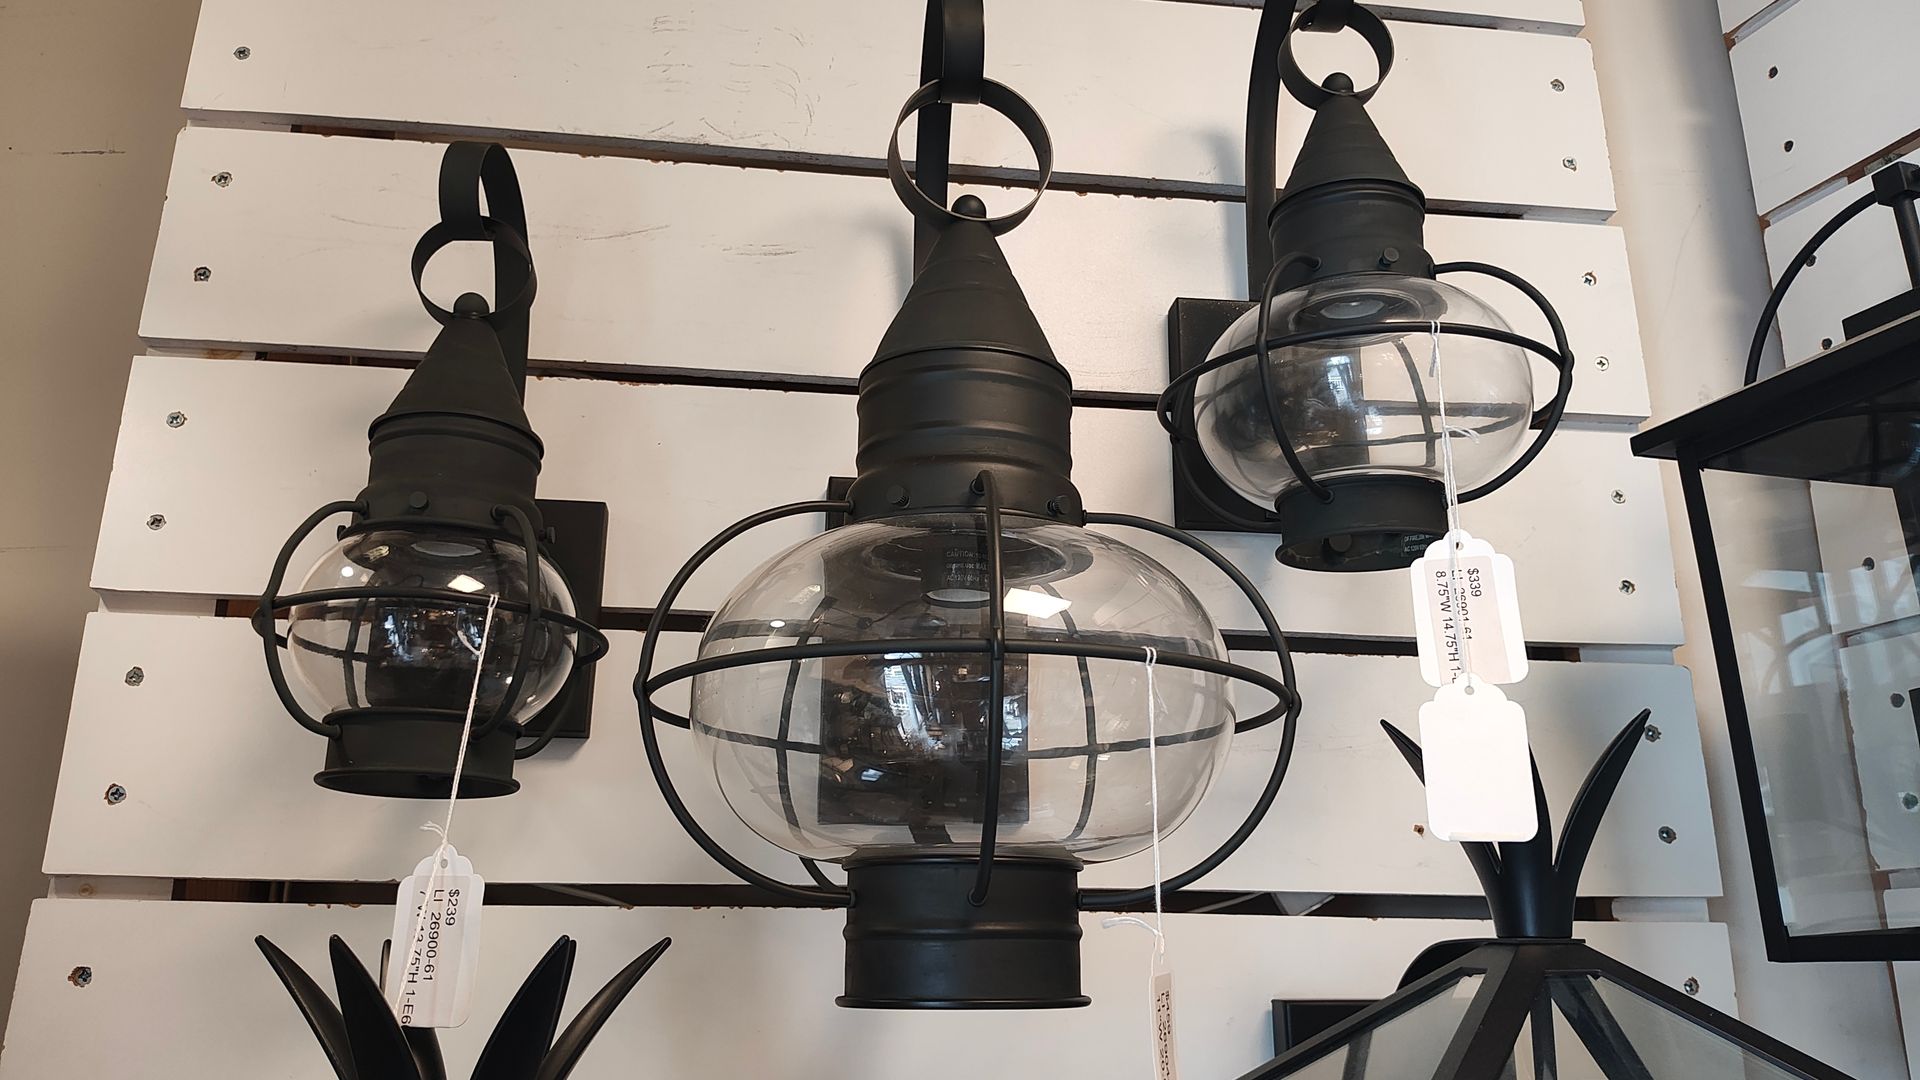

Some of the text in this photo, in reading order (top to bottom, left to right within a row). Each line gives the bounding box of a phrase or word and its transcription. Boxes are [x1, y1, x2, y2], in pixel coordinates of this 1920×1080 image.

[1435, 570, 1452, 613] 8.75"W
[1467, 567, 1482, 597] $339
[1442, 616, 1460, 662] 14.75"H
[445, 888, 460, 926] $239
[423, 889, 445, 981] LI 26900-61
